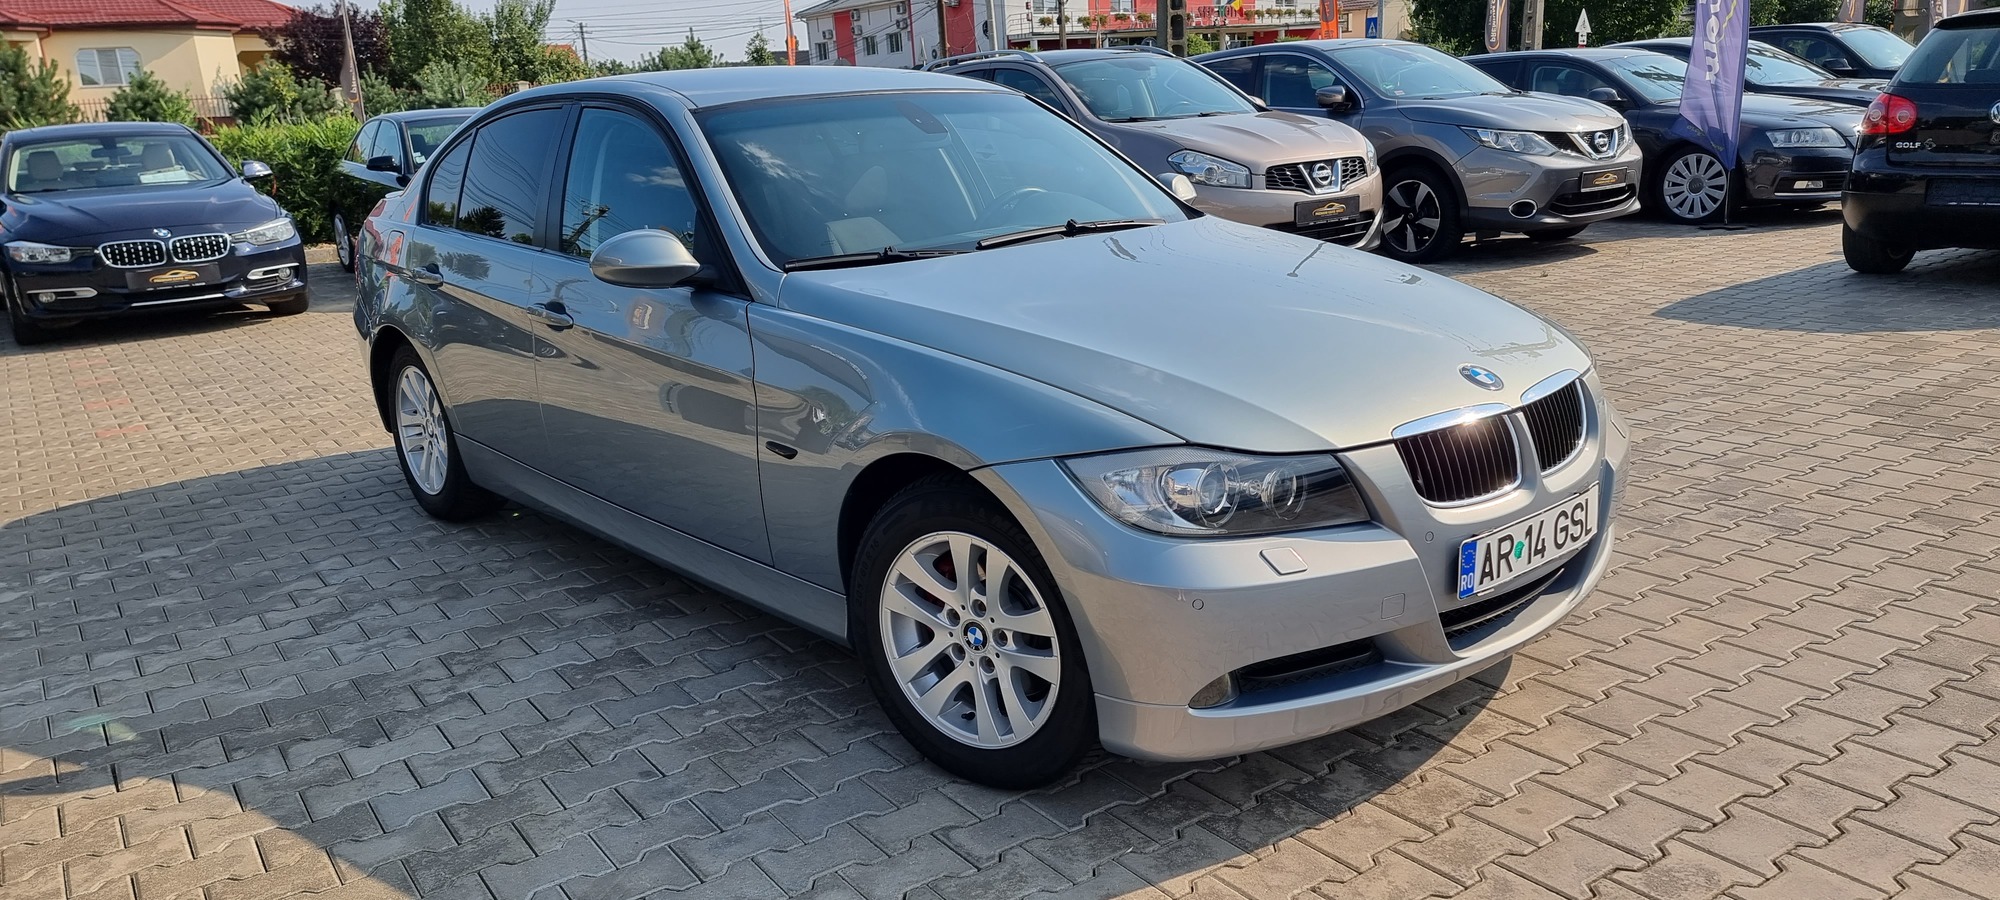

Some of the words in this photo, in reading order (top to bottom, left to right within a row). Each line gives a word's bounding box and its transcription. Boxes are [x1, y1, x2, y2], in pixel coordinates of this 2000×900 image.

[1895, 141, 1922, 149] GOLF
[1479, 533, 1514, 586] AR
[1525, 519, 1547, 565] 14
[1554, 497, 1593, 550] GSL
[1461, 572, 1474, 592] RO
